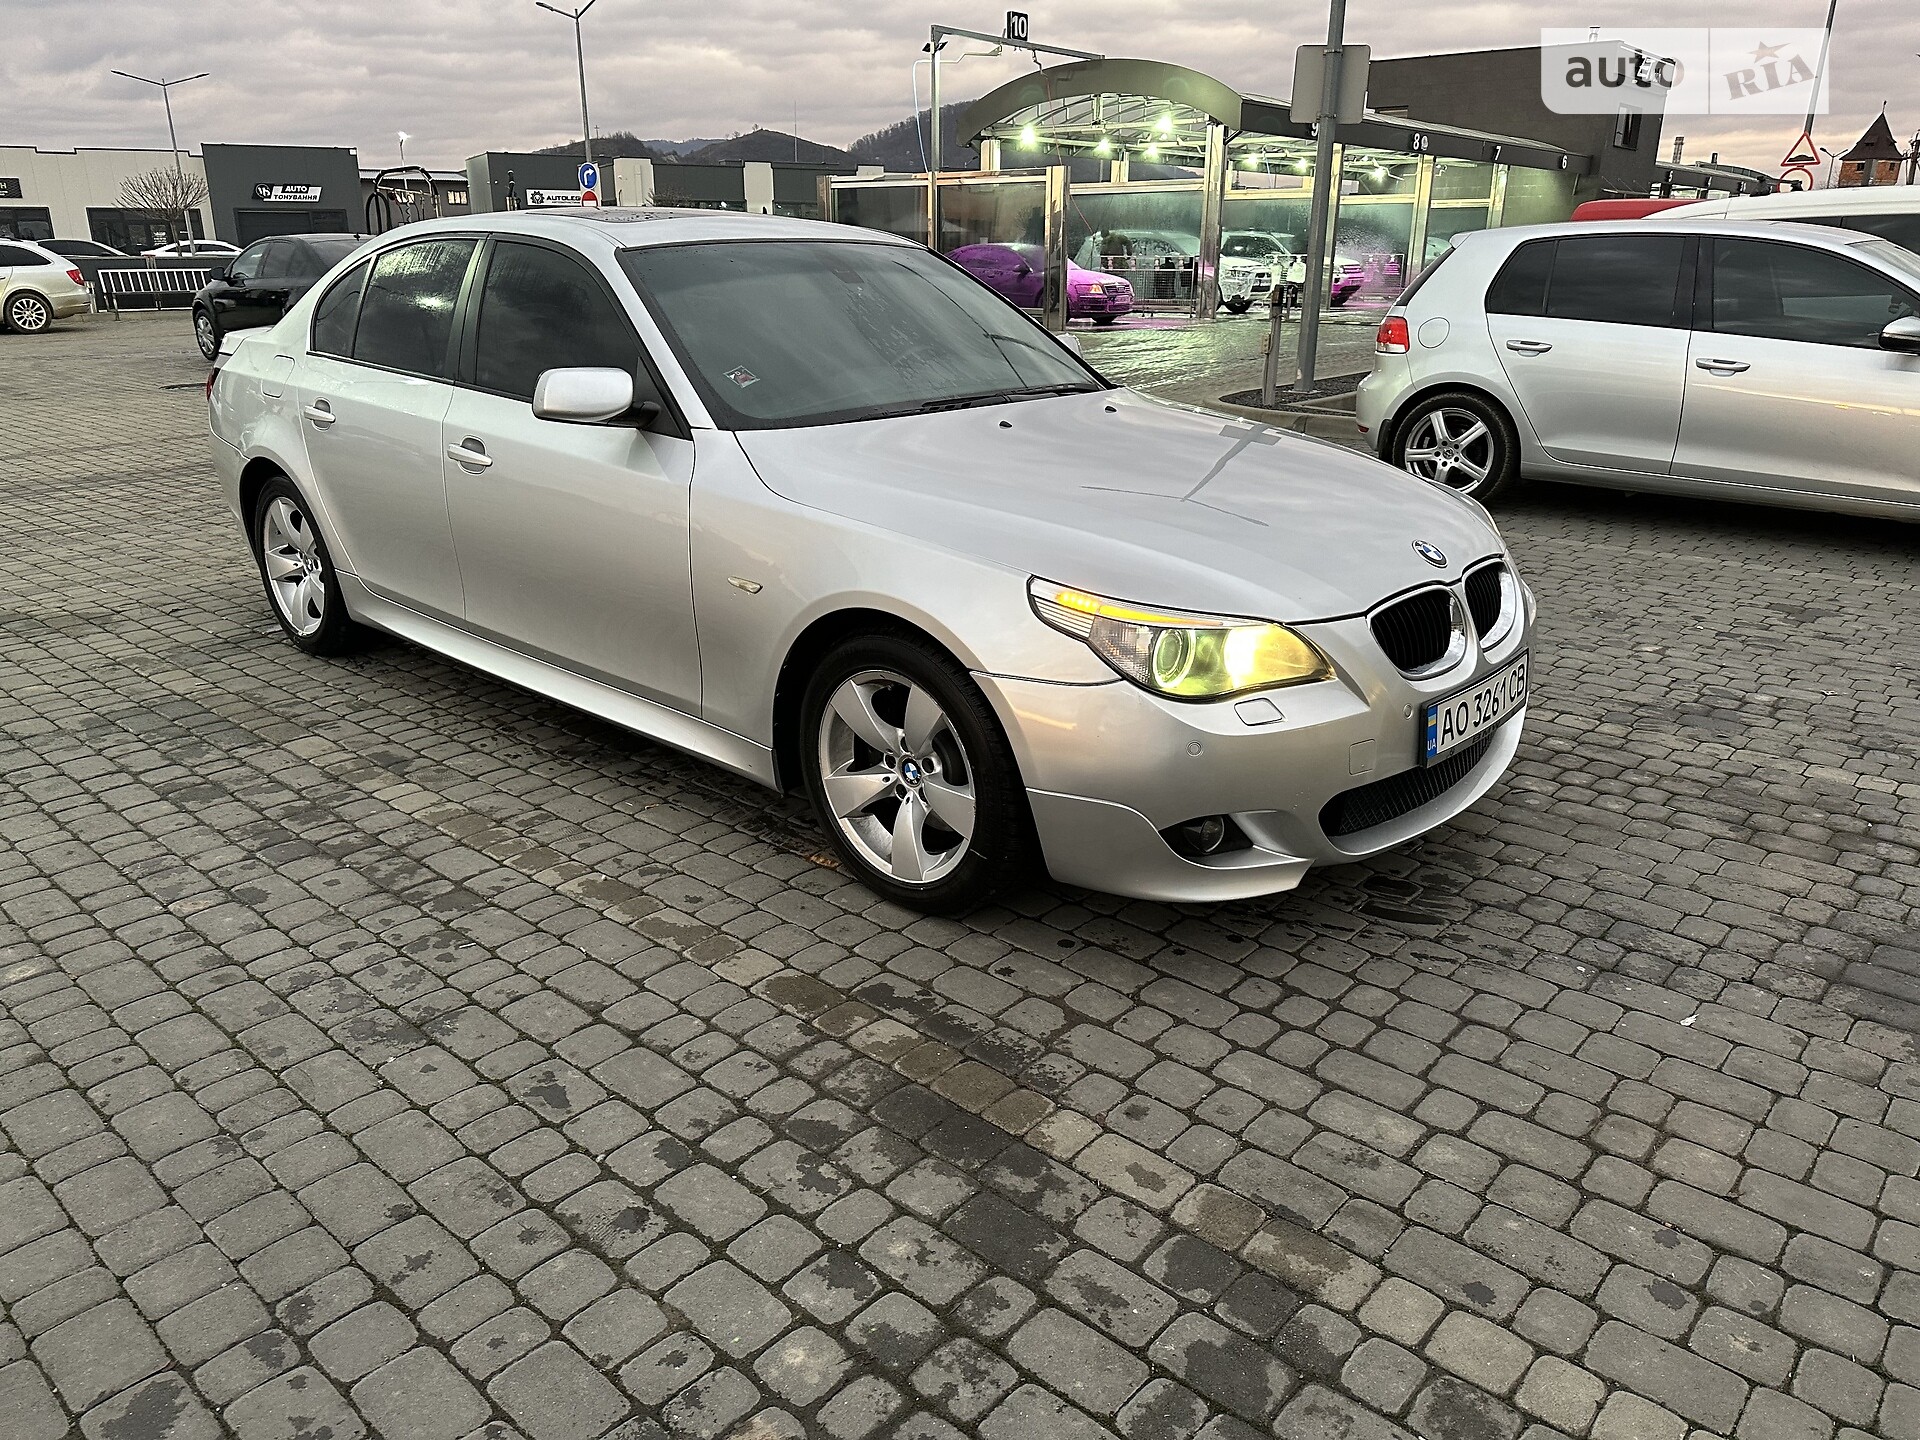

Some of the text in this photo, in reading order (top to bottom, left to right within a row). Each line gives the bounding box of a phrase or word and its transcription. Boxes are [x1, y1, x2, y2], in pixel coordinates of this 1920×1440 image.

[1012, 15, 1027, 38] 10
[1413, 132, 1421, 150] 8
[1495, 145, 1502, 161] 7
[1562, 154, 1568, 169] 6
[284, 185, 308, 193] AUTO
[1440, 664, 1525, 746] AO 3261 CB
[1427, 738, 1437, 751] UA
